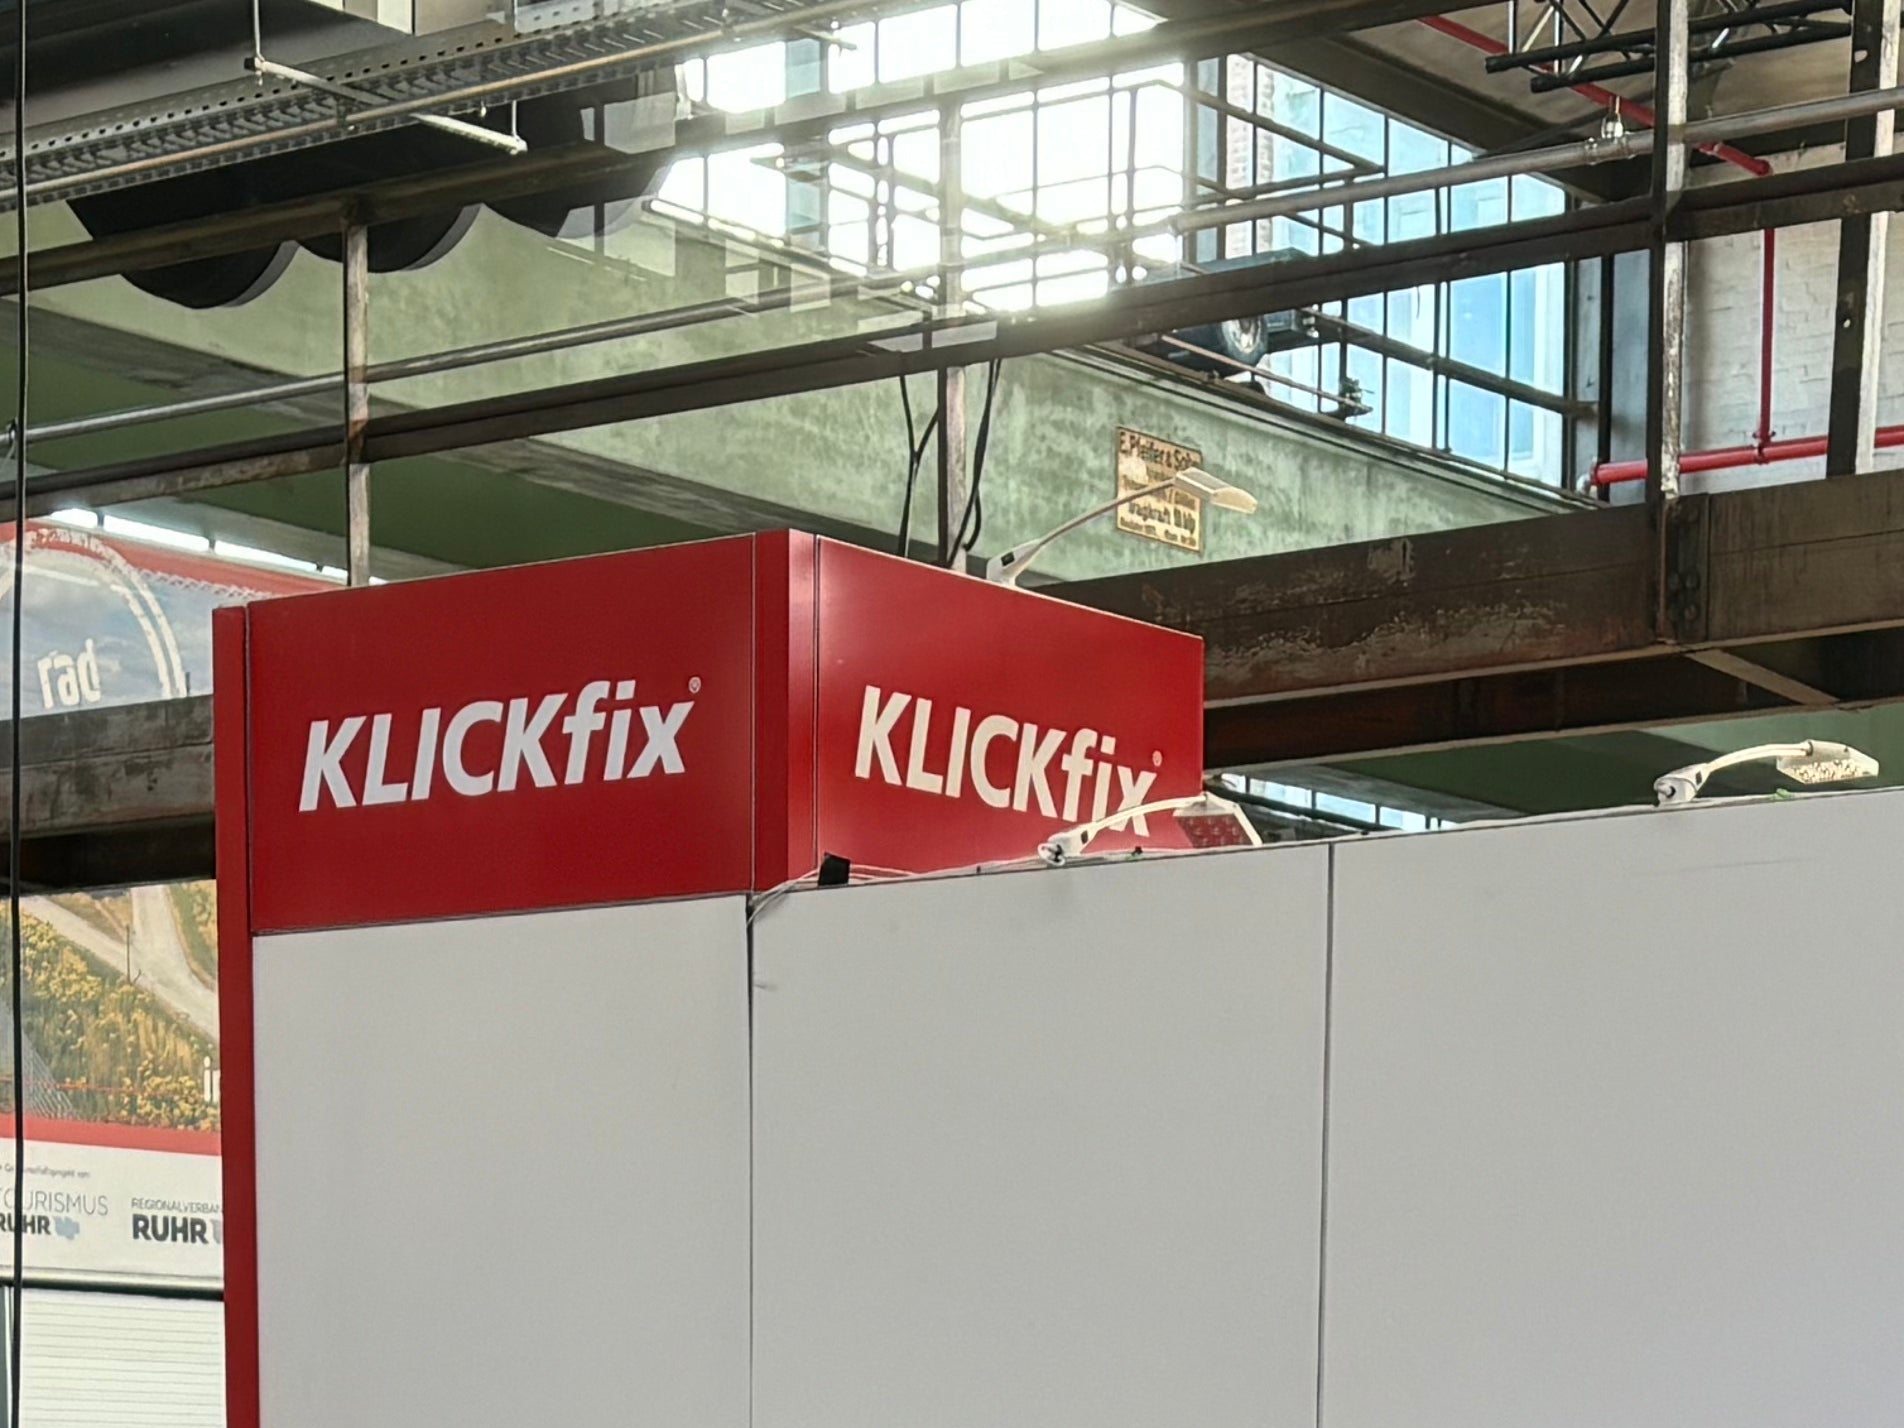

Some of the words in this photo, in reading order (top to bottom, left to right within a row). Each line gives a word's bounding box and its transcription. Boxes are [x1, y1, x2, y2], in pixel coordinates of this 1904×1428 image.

[37, 638, 101, 709] rad
[298, 680, 693, 813] KLICKfix
[854, 684, 1157, 837] KLICKfix
[132, 1213, 209, 1244] RUHR
